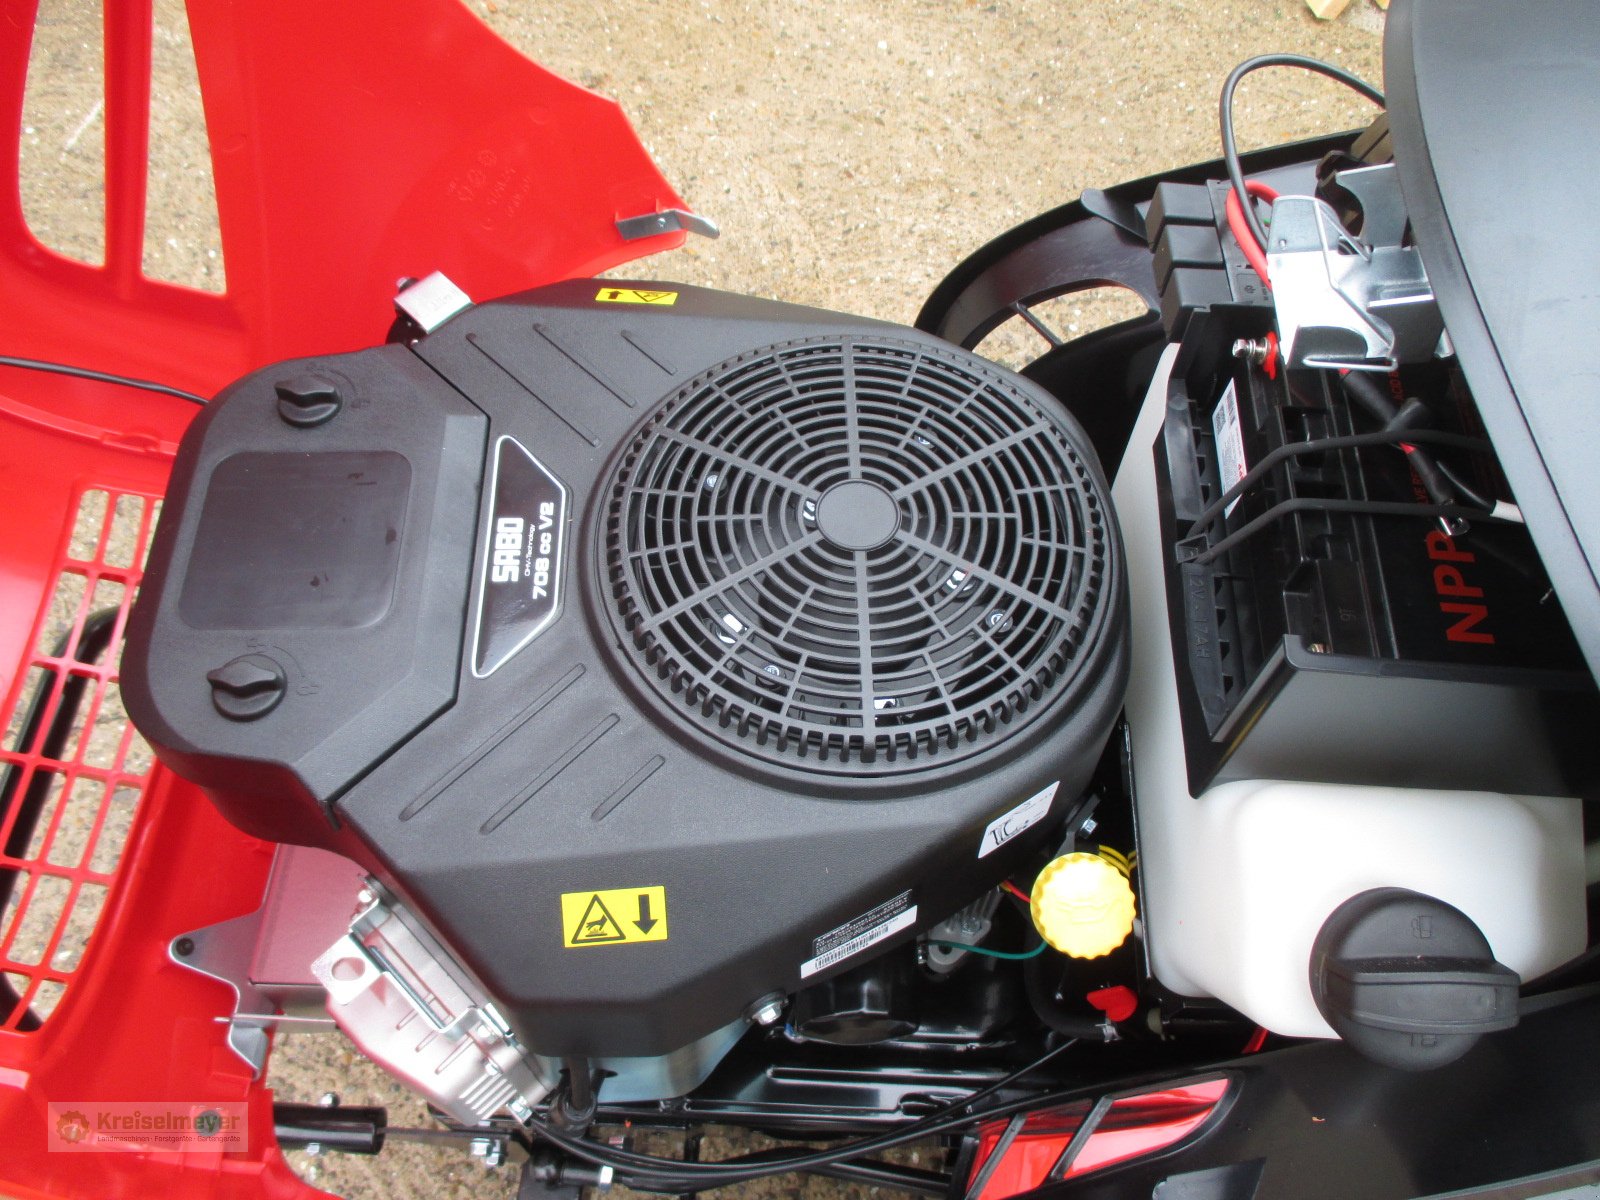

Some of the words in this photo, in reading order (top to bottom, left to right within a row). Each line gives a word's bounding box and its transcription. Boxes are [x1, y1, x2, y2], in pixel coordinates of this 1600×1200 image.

[538, 502, 555, 531] V2
[491, 517, 524, 582] SABO
[539, 532, 552, 555] cc
[532, 557, 550, 600] 708
[1426, 530, 1495, 644] NPP
